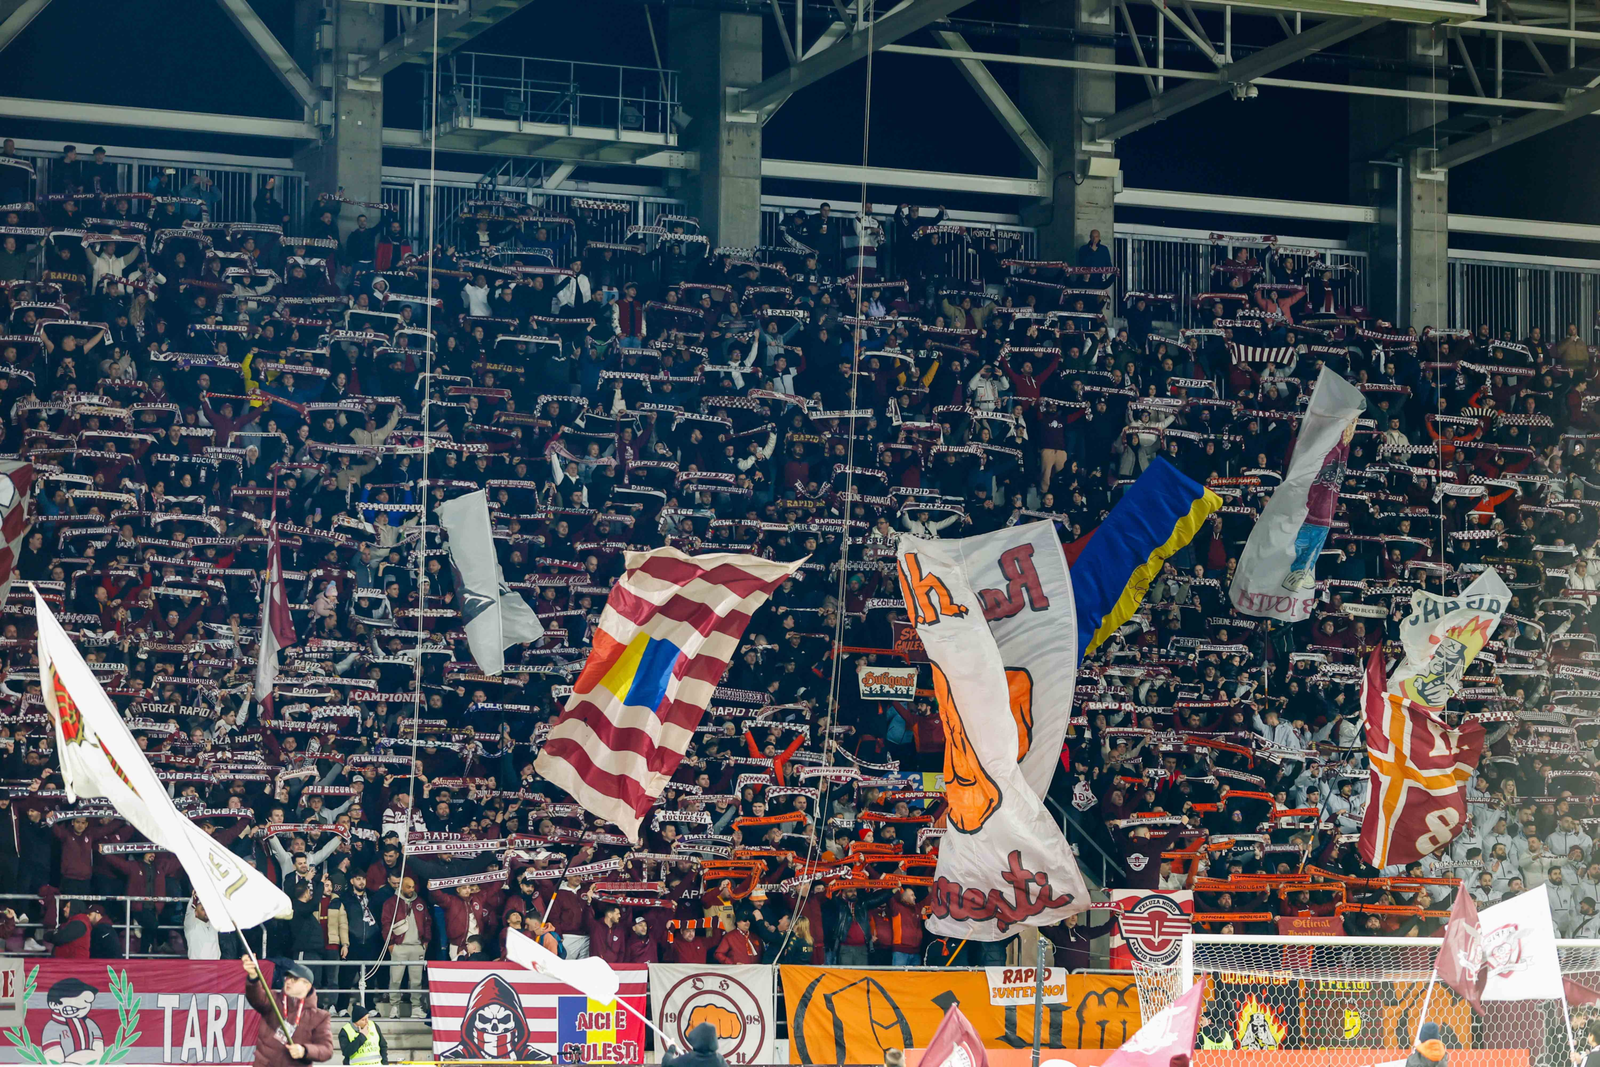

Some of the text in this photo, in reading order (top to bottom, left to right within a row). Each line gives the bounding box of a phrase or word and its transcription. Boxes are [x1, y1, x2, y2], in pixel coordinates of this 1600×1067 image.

[974, 230, 994, 238] ORZA
[50, 273, 78, 281] RAPID
[339, 330, 374, 338] RAPID
[1495, 341, 1522, 350] RAPID
[1481, 365, 1528, 375] RAPID BUCURESTI
[1179, 379, 1207, 388] RAPID
[1144, 398, 1181, 406] RAPID
[685, 413, 721, 422] RAPID
[629, 460, 677, 469] RAPID 100
[1439, 470, 1454, 478] 100
[900, 487, 929, 495] RAPID
[842, 492, 891, 505] EGIONE GRANATA
[920, 503, 951, 511] RAPID
[1222, 506, 1250, 514] RAPID
[279, 524, 344, 540] FORZA RAPID
[789, 524, 808, 532] UPER
[4, 606, 22, 614] GIONE
[1211, 617, 1255, 630] LEGIONE GRANATA
[1179, 639, 1200, 647] RAPID
[1561, 666, 1584, 674] FORZA
[1089, 702, 1119, 710] RAPID
[142, 704, 209, 717] FORZA RAPID
[743, 708, 759, 716] 10
[211, 736, 230, 744] RZA
[156, 772, 209, 780] OMBRIE
[188, 808, 254, 817] CTOMBRIE
[424, 832, 461, 840] RAPID
[116, 844, 166, 852] MILITA
[414, 844, 434, 852] AICI
[567, 862, 612, 874] GIULESTI
[1138, 899, 1177, 913] PELUZA NORD
[1292, 918, 1331, 928] Official
[1131, 941, 1148, 961] RAPID
[576, 1010, 627, 1031] AICI E
[664, 1012, 761, 1025] 19 98
[157, 993, 245, 1064] TARI
